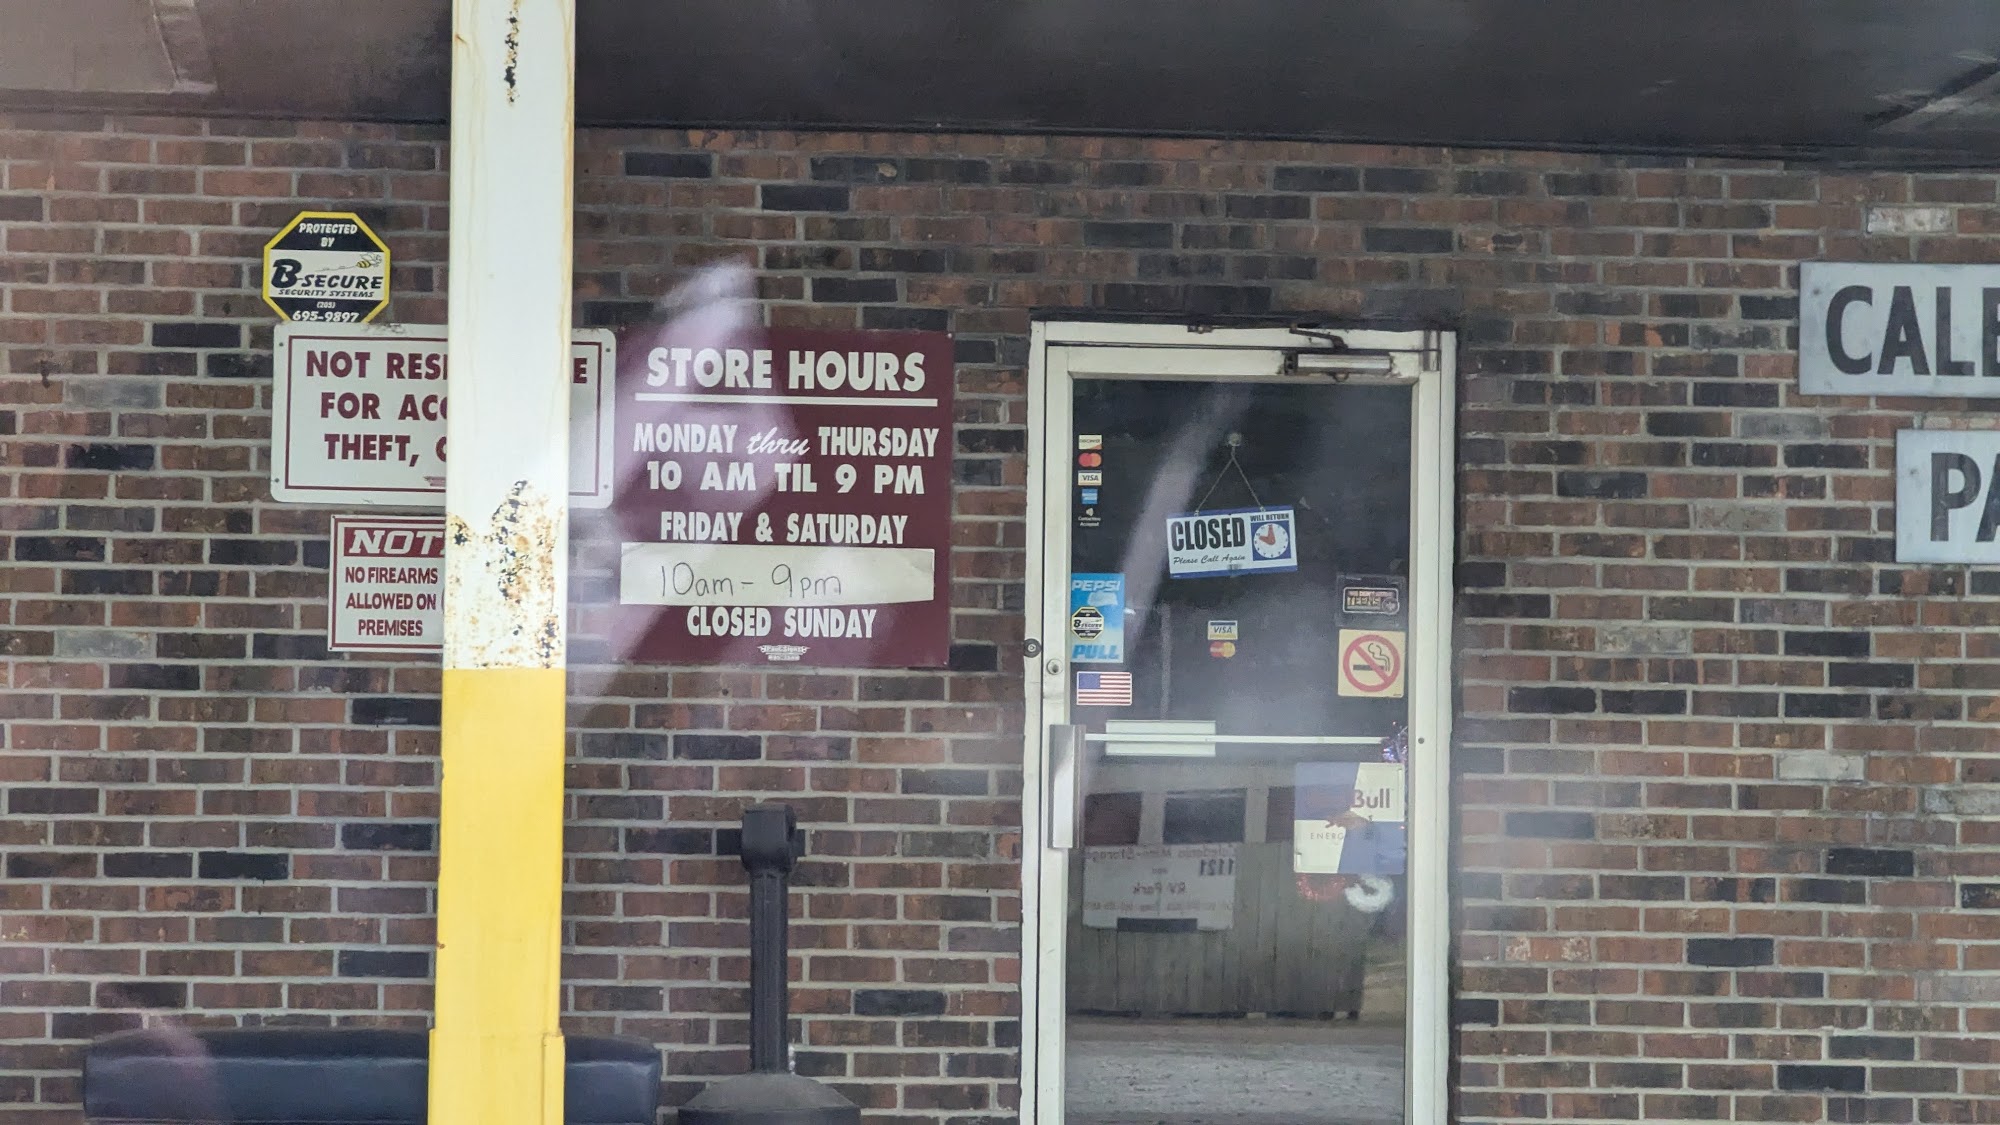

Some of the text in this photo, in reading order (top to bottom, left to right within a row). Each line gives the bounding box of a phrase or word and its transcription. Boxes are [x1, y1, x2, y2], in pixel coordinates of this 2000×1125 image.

[299, 223, 358, 234] PROTECTED
[320, 237, 335, 247] BY
[271, 258, 383, 290] B-SECURE
[317, 301, 336, 309] (205)
[329, 290, 375, 298] SYSTEMS
[292, 310, 359, 322] 695-9897
[306, 350, 371, 379] NOT
[386, 352, 448, 380] RES
[646, 347, 926, 392] STORE HOURS
[321, 391, 380, 420] FOR
[324, 433, 420, 467] THEFT,
[633, 422, 939, 457] MONDAY thru THURSDAY
[646, 460, 925, 494] 10 AM TIL 9 PM
[660, 511, 908, 544] FRIDAY & SATURDAY
[1265, 513, 1290, 521] RETURN
[348, 529, 445, 555] NOT
[1170, 517, 1246, 552] CLOSED
[1173, 553, 1246, 565] Please Call Again
[345, 566, 438, 585] NO FIREARMS
[771, 563, 842, 598] 9pm
[1072, 580, 1120, 591] PEPSI
[345, 592, 436, 610] ALLOWED ON
[358, 619, 423, 637] PREMISES
[686, 606, 877, 639] CLOSED SUNDAY
[1072, 644, 1120, 659] PULL
